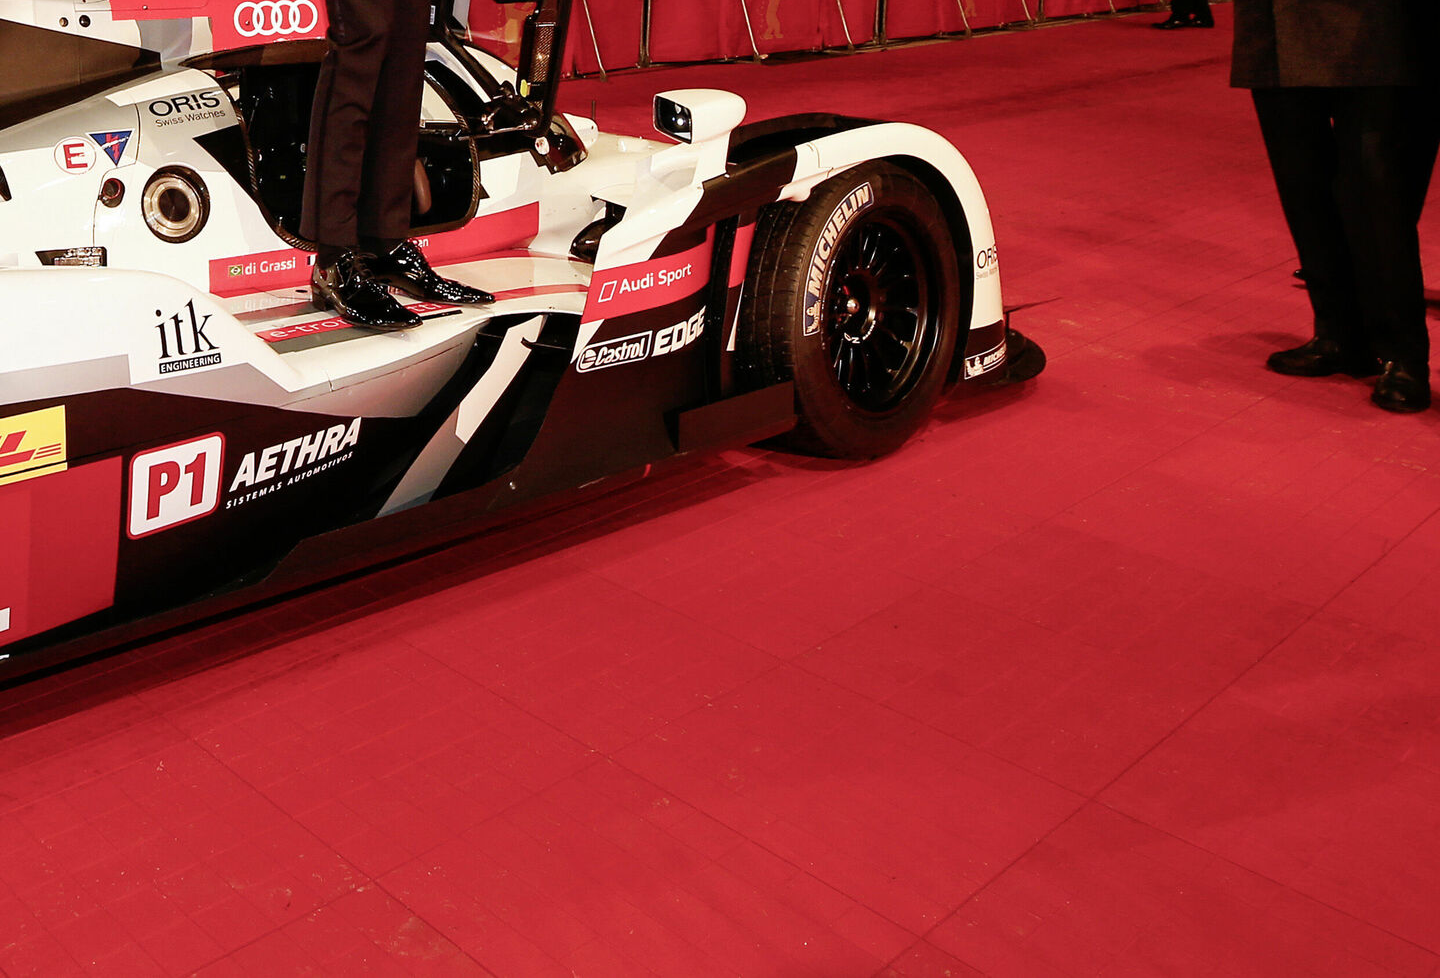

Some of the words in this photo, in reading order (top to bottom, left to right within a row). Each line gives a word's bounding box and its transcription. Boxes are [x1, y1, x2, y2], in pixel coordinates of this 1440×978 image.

[148, 91, 221, 117] ORIS
[155, 116, 184, 128] Swiss
[185, 109, 226, 123] Watches
[244, 261, 257, 275] di
[260, 257, 296, 273] Grassi
[808, 185, 870, 297] MICHELIN
[619, 272, 654, 295] Audi
[658, 263, 692, 286] Sport
[154, 297, 220, 360] itk
[594, 337, 647, 366] Castrol
[651, 305, 707, 358] EDGE
[160, 353, 221, 374] ENGINEERING
[226, 481, 282, 510] SISTEMAS
[287, 450, 353, 486] AUTOMOTIVOS
[228, 416, 362, 493] AETHRA
[145, 451, 208, 521] P1
